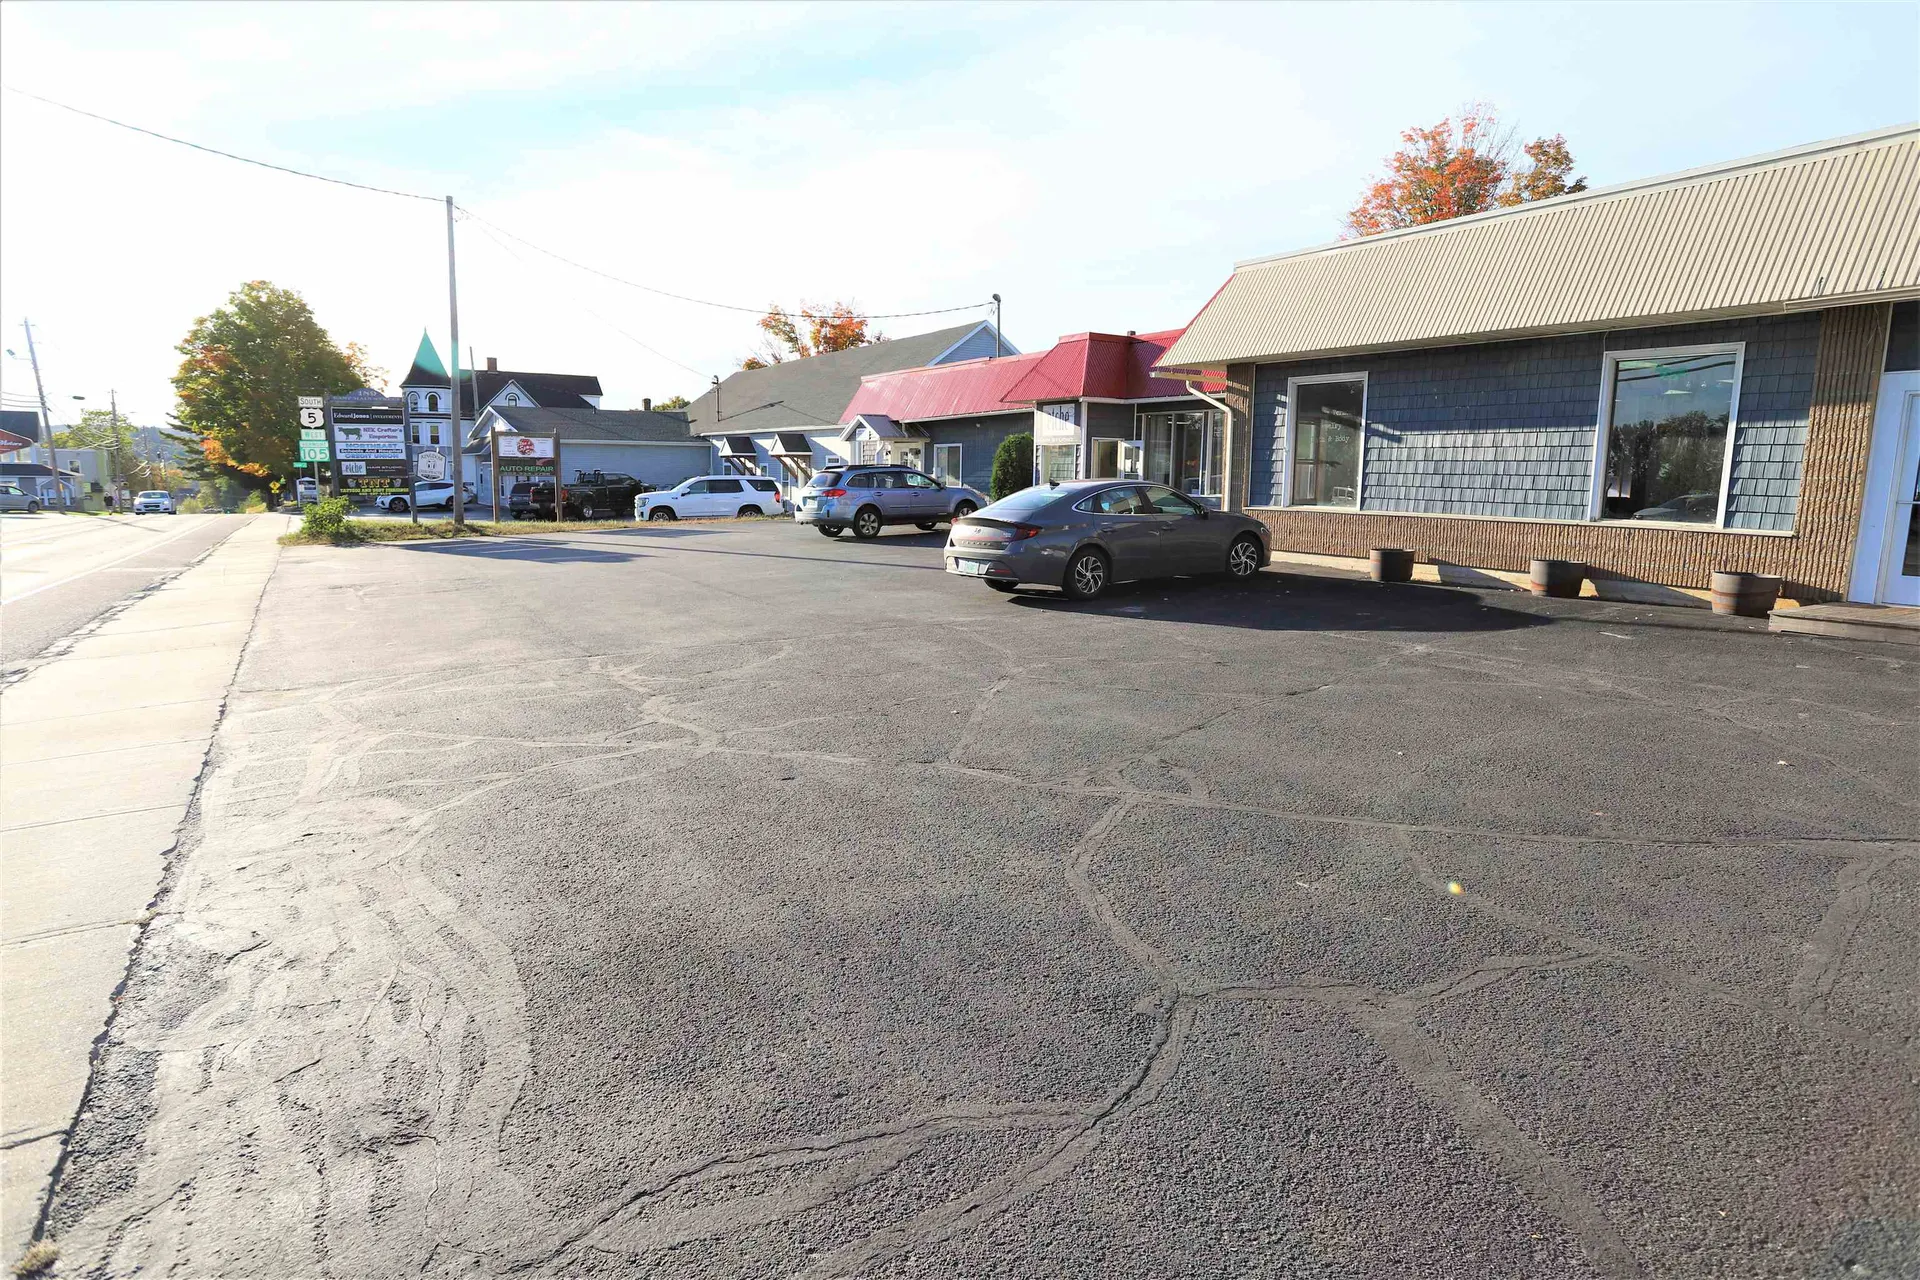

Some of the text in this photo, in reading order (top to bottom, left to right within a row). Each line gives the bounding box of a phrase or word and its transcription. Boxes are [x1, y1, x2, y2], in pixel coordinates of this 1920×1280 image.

[300, 397, 321, 406] SOUTH
[308, 412, 317, 424] 5
[303, 448, 328, 460] 105
[500, 465, 554, 473] AUTO REPAIR
[357, 478, 391, 488] TNT
